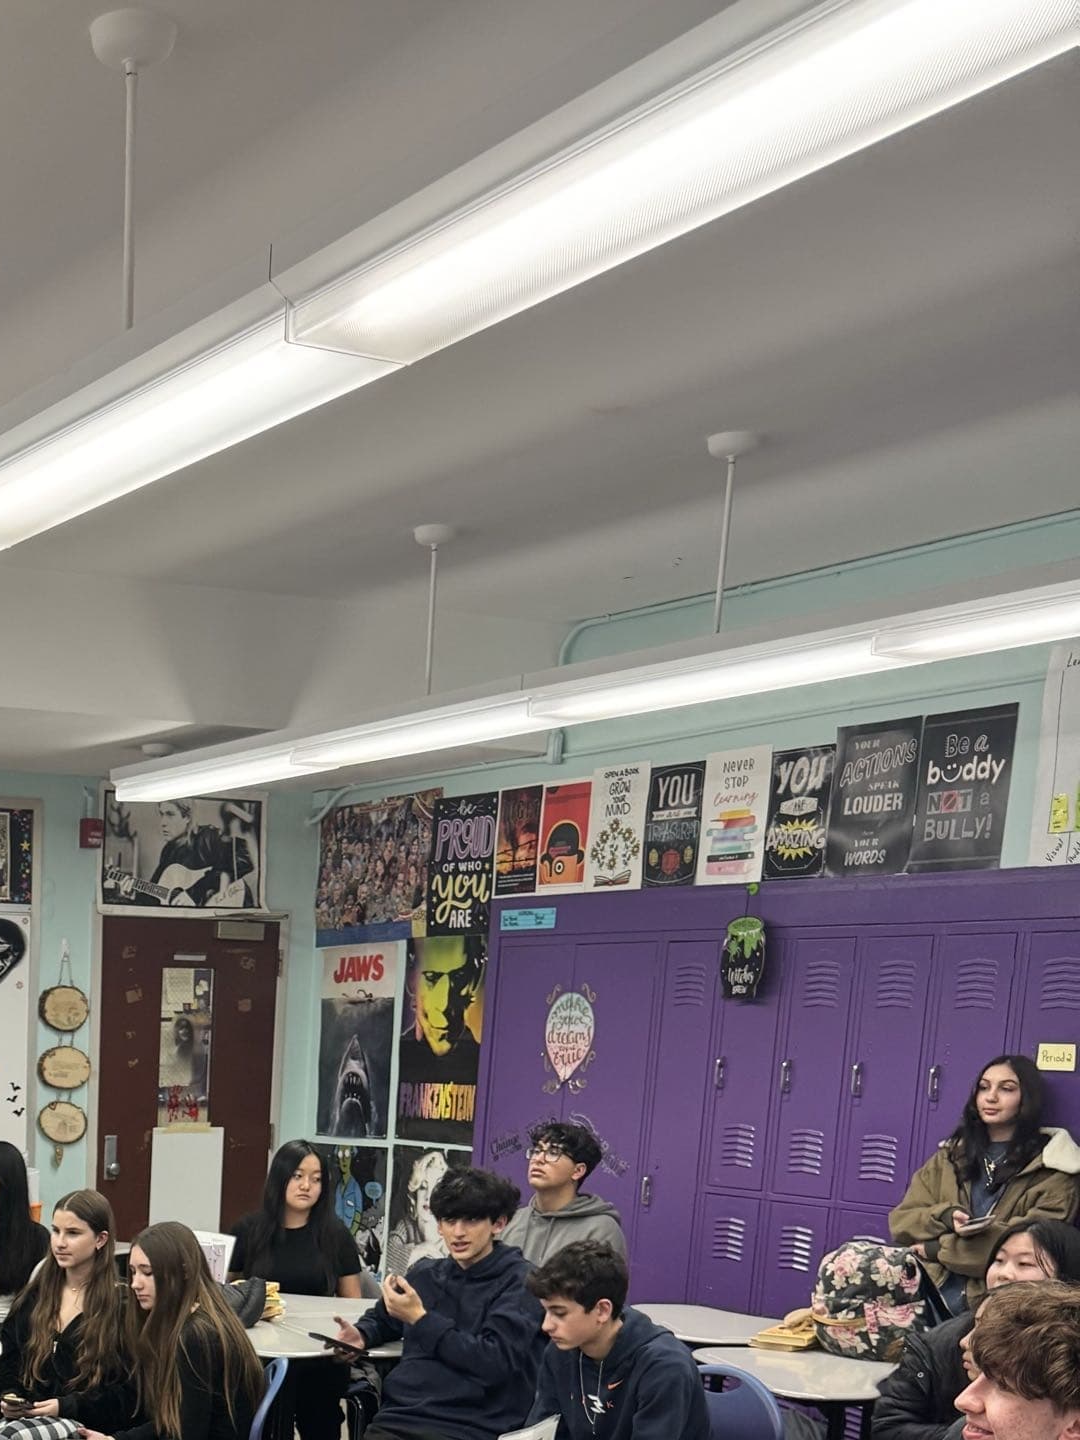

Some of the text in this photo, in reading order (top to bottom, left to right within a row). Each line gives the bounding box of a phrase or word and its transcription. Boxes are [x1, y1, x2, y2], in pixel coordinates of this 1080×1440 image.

[855, 740, 880, 750] YOUR
[945, 733, 990, 757] Be a
[604, 771, 620, 779] OPEN
[625, 768, 639, 776] BOOK
[777, 756, 827, 793] YOU
[839, 738, 918, 788] ACTIONS
[609, 780, 631, 795] GROW
[659, 773, 695, 808] YOU
[868, 781, 900, 792] SPEAK
[457, 800, 477, 815] be
[605, 802, 631, 817] MIND
[843, 793, 904, 816] LOUDER
[926, 789, 990, 815] NOT a
[435, 815, 496, 862] PROUD
[765, 828, 825, 851] AMAZING
[442, 861, 482, 872] OF WHO
[844, 849, 886, 866] WORDS
[432, 873, 490, 924] you
[448, 909, 471, 928] ARE
[334, 953, 384, 984] JAWS
[1042, 1050, 1064, 1062] Period
[399, 1081, 477, 1121] FRANKENSTEIN
